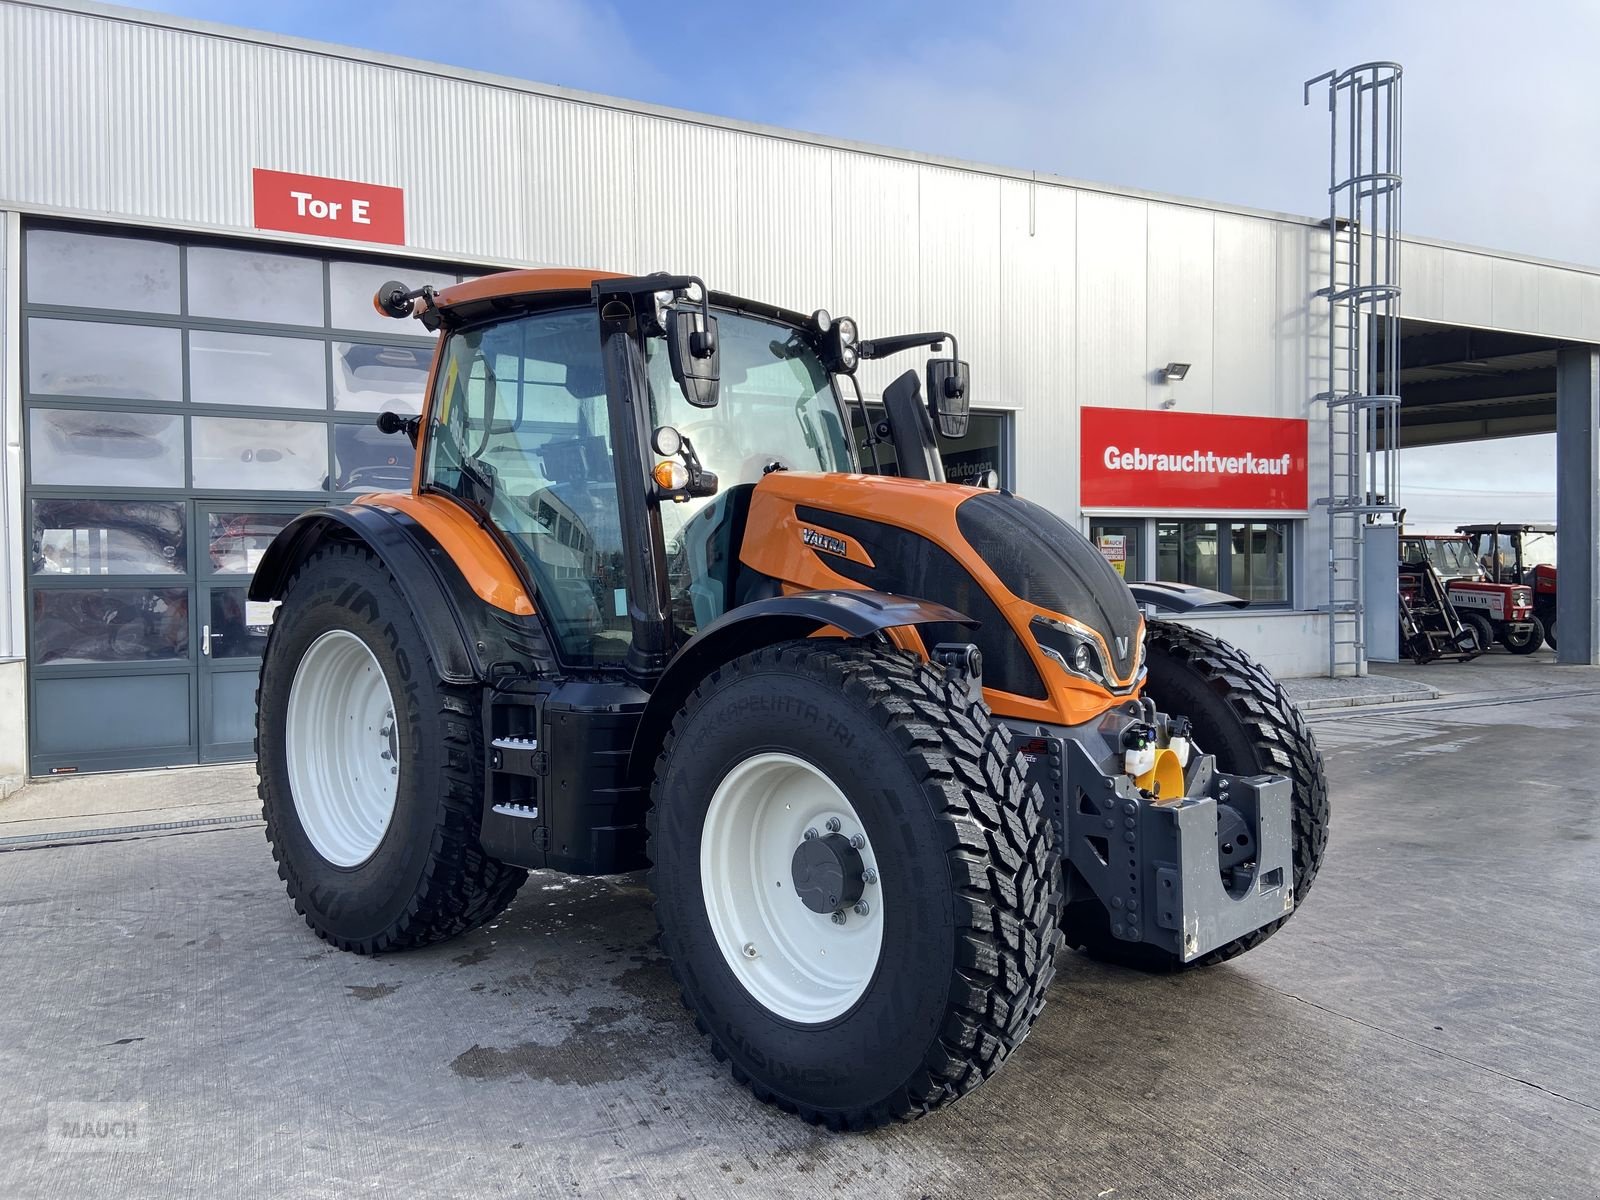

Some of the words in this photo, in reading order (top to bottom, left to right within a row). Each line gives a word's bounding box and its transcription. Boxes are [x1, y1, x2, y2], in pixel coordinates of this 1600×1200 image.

[290, 191, 342, 220] Tor
[352, 199, 371, 224] E
[944, 461, 993, 478] Traktoren
[1104, 446, 1290, 475] Gebrauchtverkauf
[803, 528, 846, 556] VALTRA
